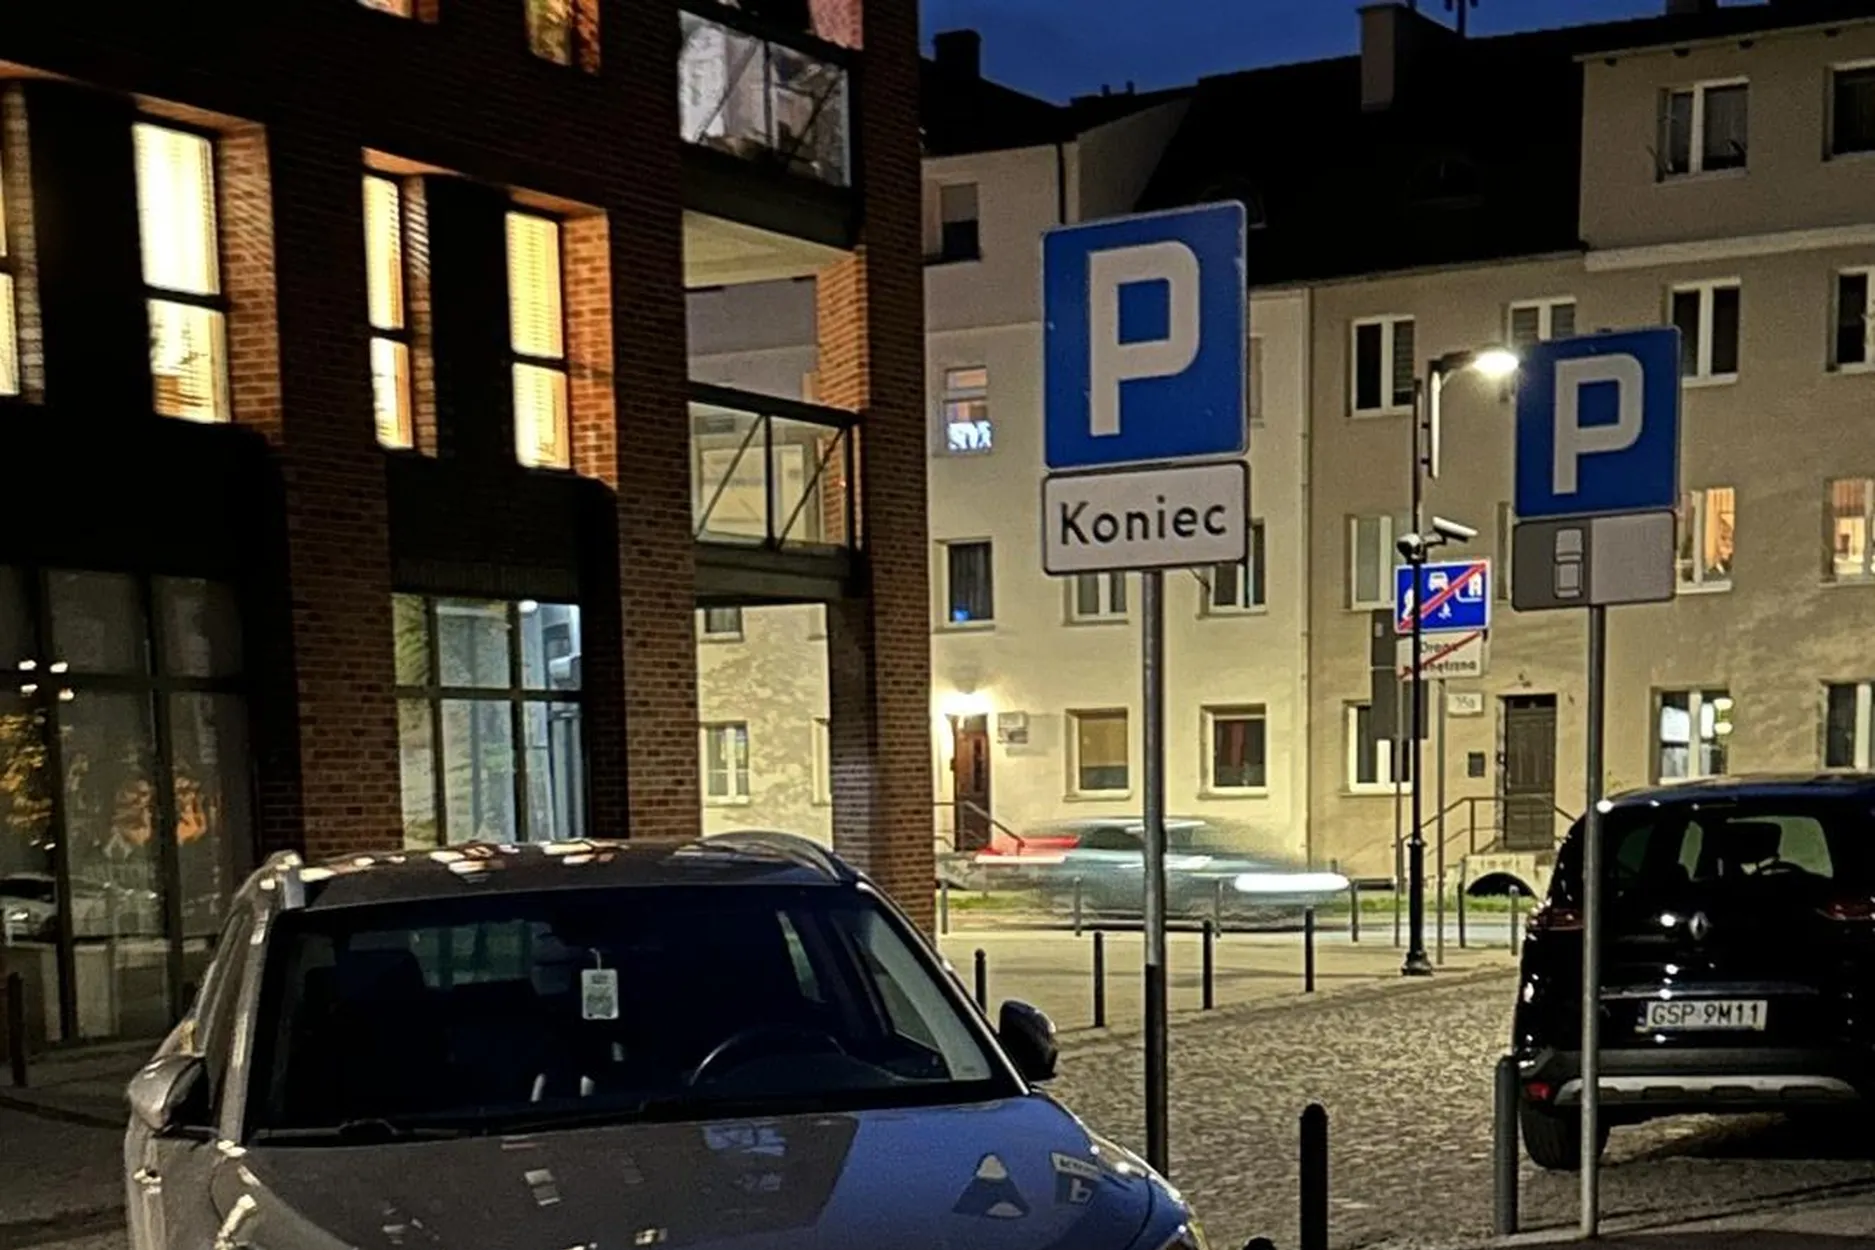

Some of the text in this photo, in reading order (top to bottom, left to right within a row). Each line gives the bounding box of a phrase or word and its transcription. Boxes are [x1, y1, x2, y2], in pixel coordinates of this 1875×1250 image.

[1088, 240, 1200, 437] P
[1552, 353, 1643, 496] P
[1060, 495, 1227, 545] Koniec
[1652, 1003, 1758, 1025] GSP 9M11
